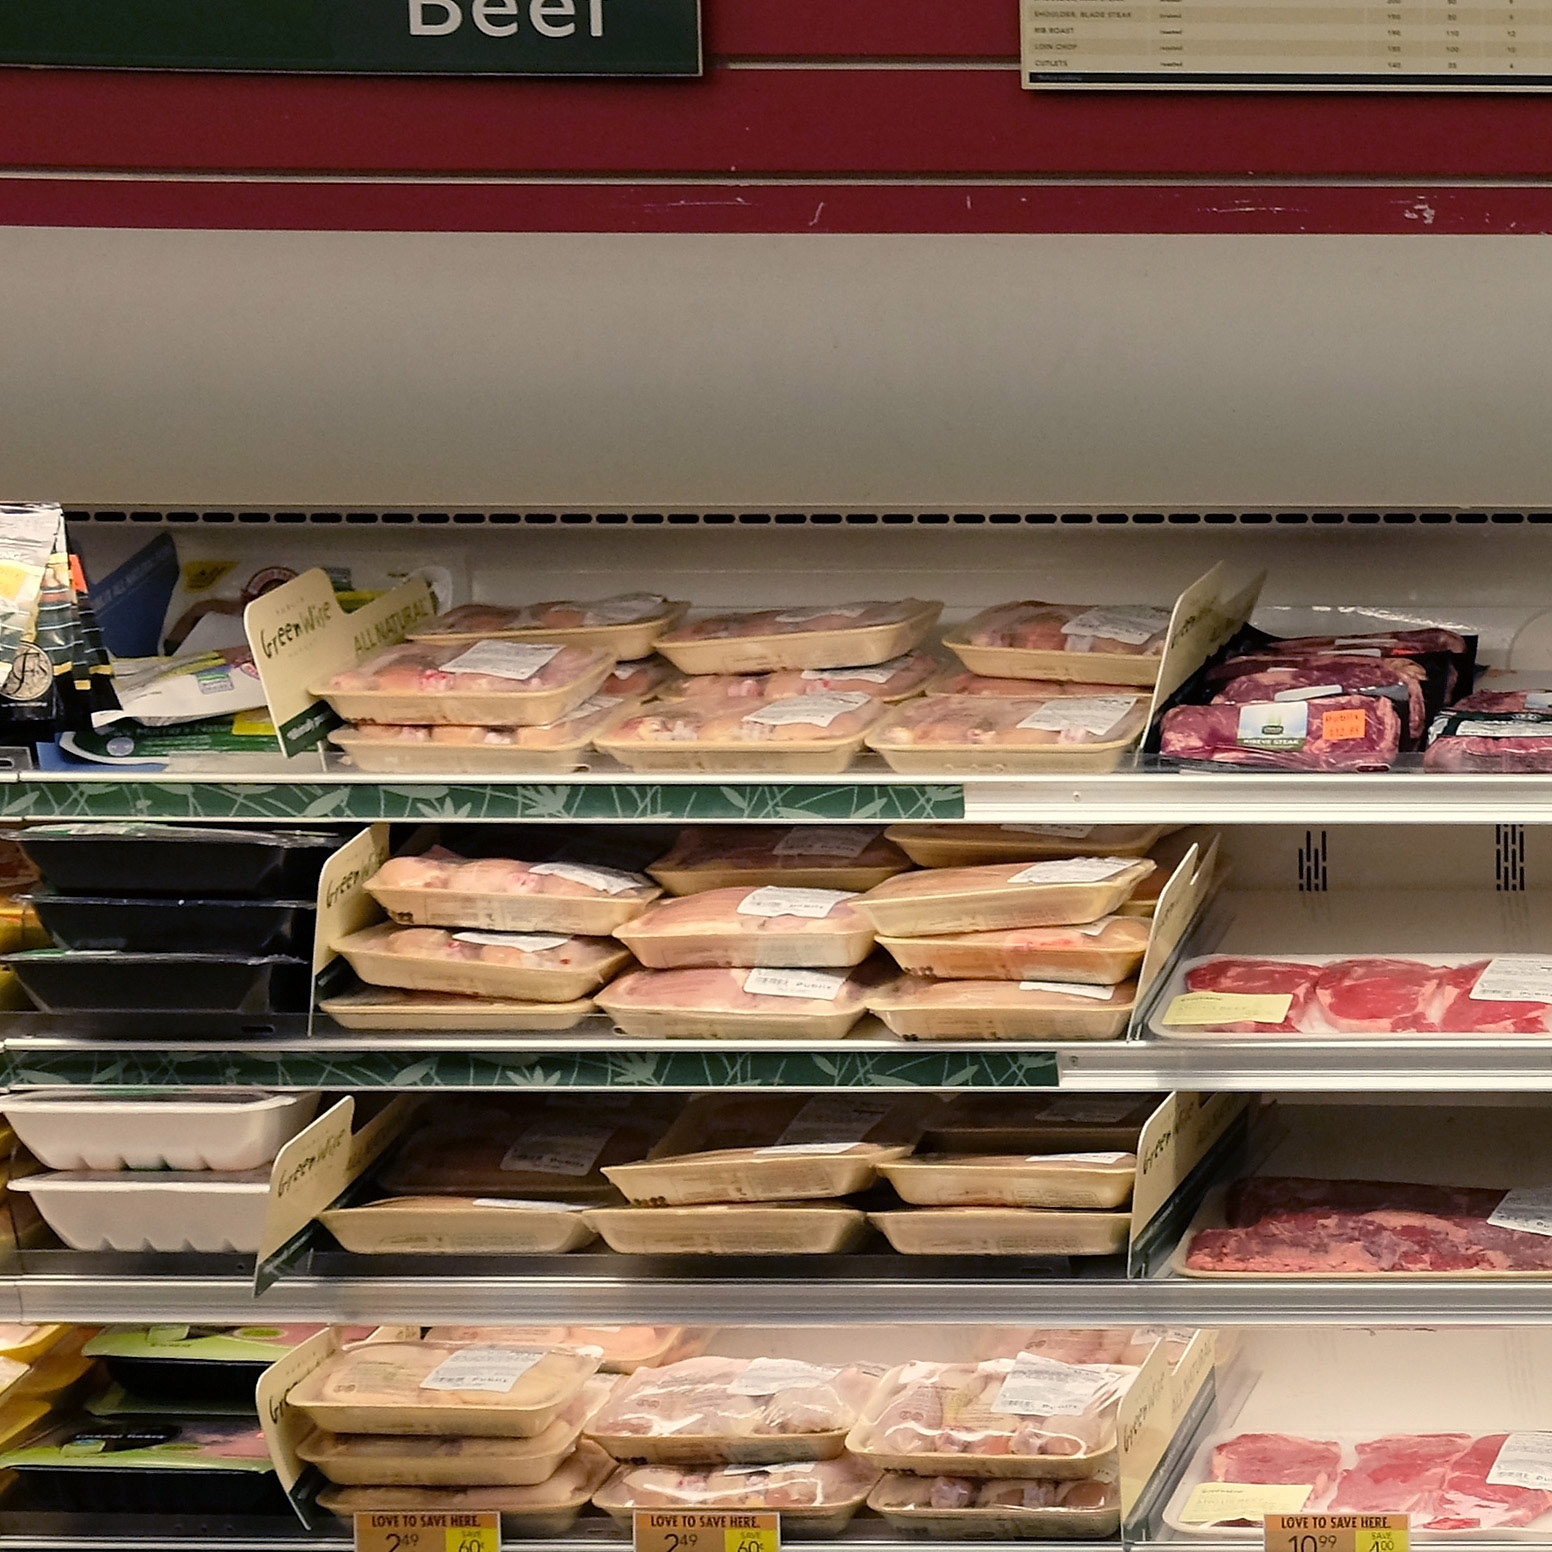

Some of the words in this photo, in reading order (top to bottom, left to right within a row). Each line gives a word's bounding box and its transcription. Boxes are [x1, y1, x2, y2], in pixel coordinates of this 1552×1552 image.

[372, 1515, 398, 1527] LOVE
[403, 1515, 417, 1527] TO
[421, 1515, 447, 1527] SAVE
[450, 1515, 481, 1527] HERE.
[651, 1516, 677, 1528] LOVE
[683, 1516, 696, 1528] TO
[700, 1516, 726, 1528] SAVE
[730, 1516, 761, 1528] HERE.
[1281, 1516, 1308, 1528] LOVE
[1313, 1516, 1326, 1528] TO
[1331, 1516, 1357, 1528] SAVE
[1361, 1516, 1391, 1528] HERE.
